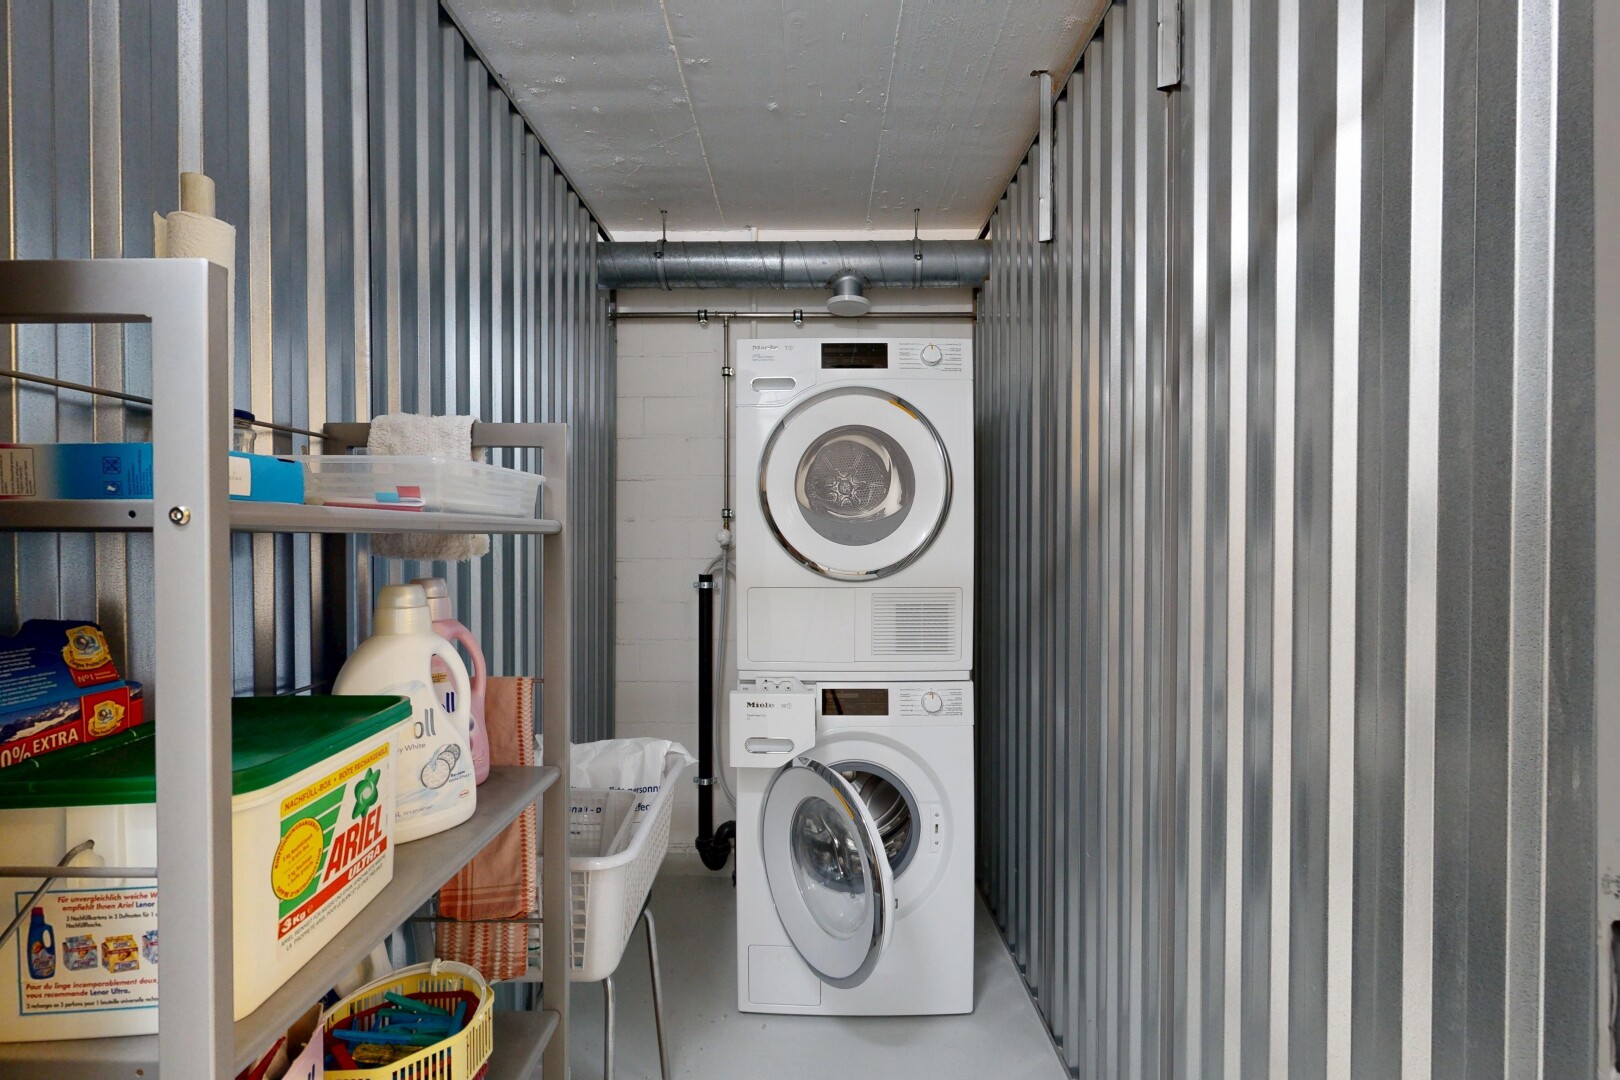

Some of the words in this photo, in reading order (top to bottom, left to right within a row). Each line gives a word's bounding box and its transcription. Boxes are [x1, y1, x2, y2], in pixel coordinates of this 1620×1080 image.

[414, 708, 436, 740] oll
[33, 728, 78, 754] EXTRA
[404, 743, 426, 752] White
[284, 780, 332, 811] NACHFÜLL-BOX
[322, 804, 382, 884] ARIEL
[348, 844, 380, 880] ULTRA
[62, 902, 94, 912] empfiehlt
[70, 894, 122, 904] unvergleichlich
[26, 983, 42, 991] Pour
[54, 982, 71, 990] linge
[73, 978, 138, 989] incomparablement
[44, 990, 88, 998] recommande
